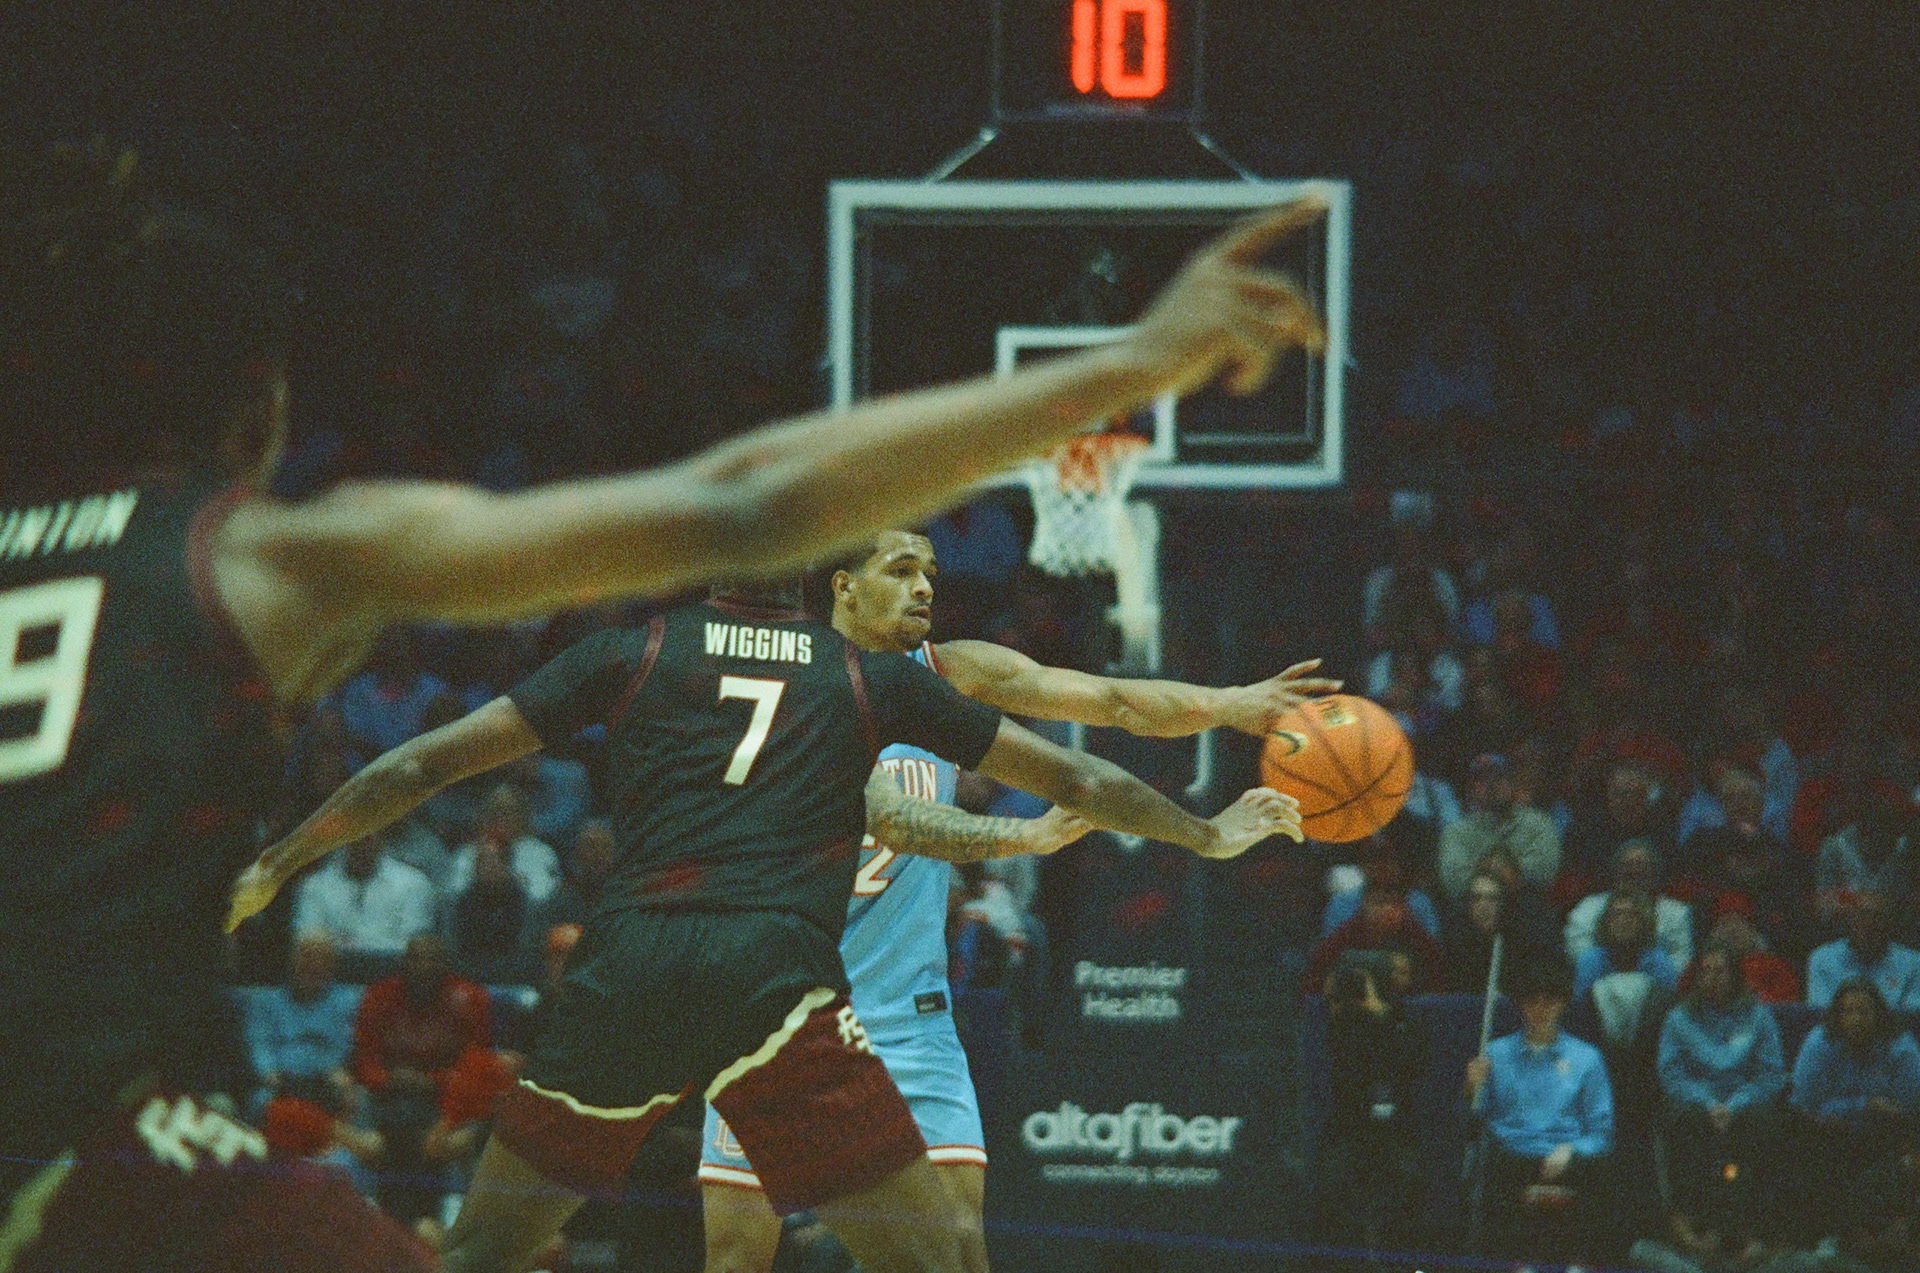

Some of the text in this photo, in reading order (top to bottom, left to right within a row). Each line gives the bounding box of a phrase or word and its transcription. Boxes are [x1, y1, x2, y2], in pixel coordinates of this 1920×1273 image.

[1071, 0, 1167, 98] 10
[0, 575, 104, 781] 9
[705, 622, 812, 664] WIGGINS
[718, 674, 787, 786] 7
[880, 757, 937, 801] TON
